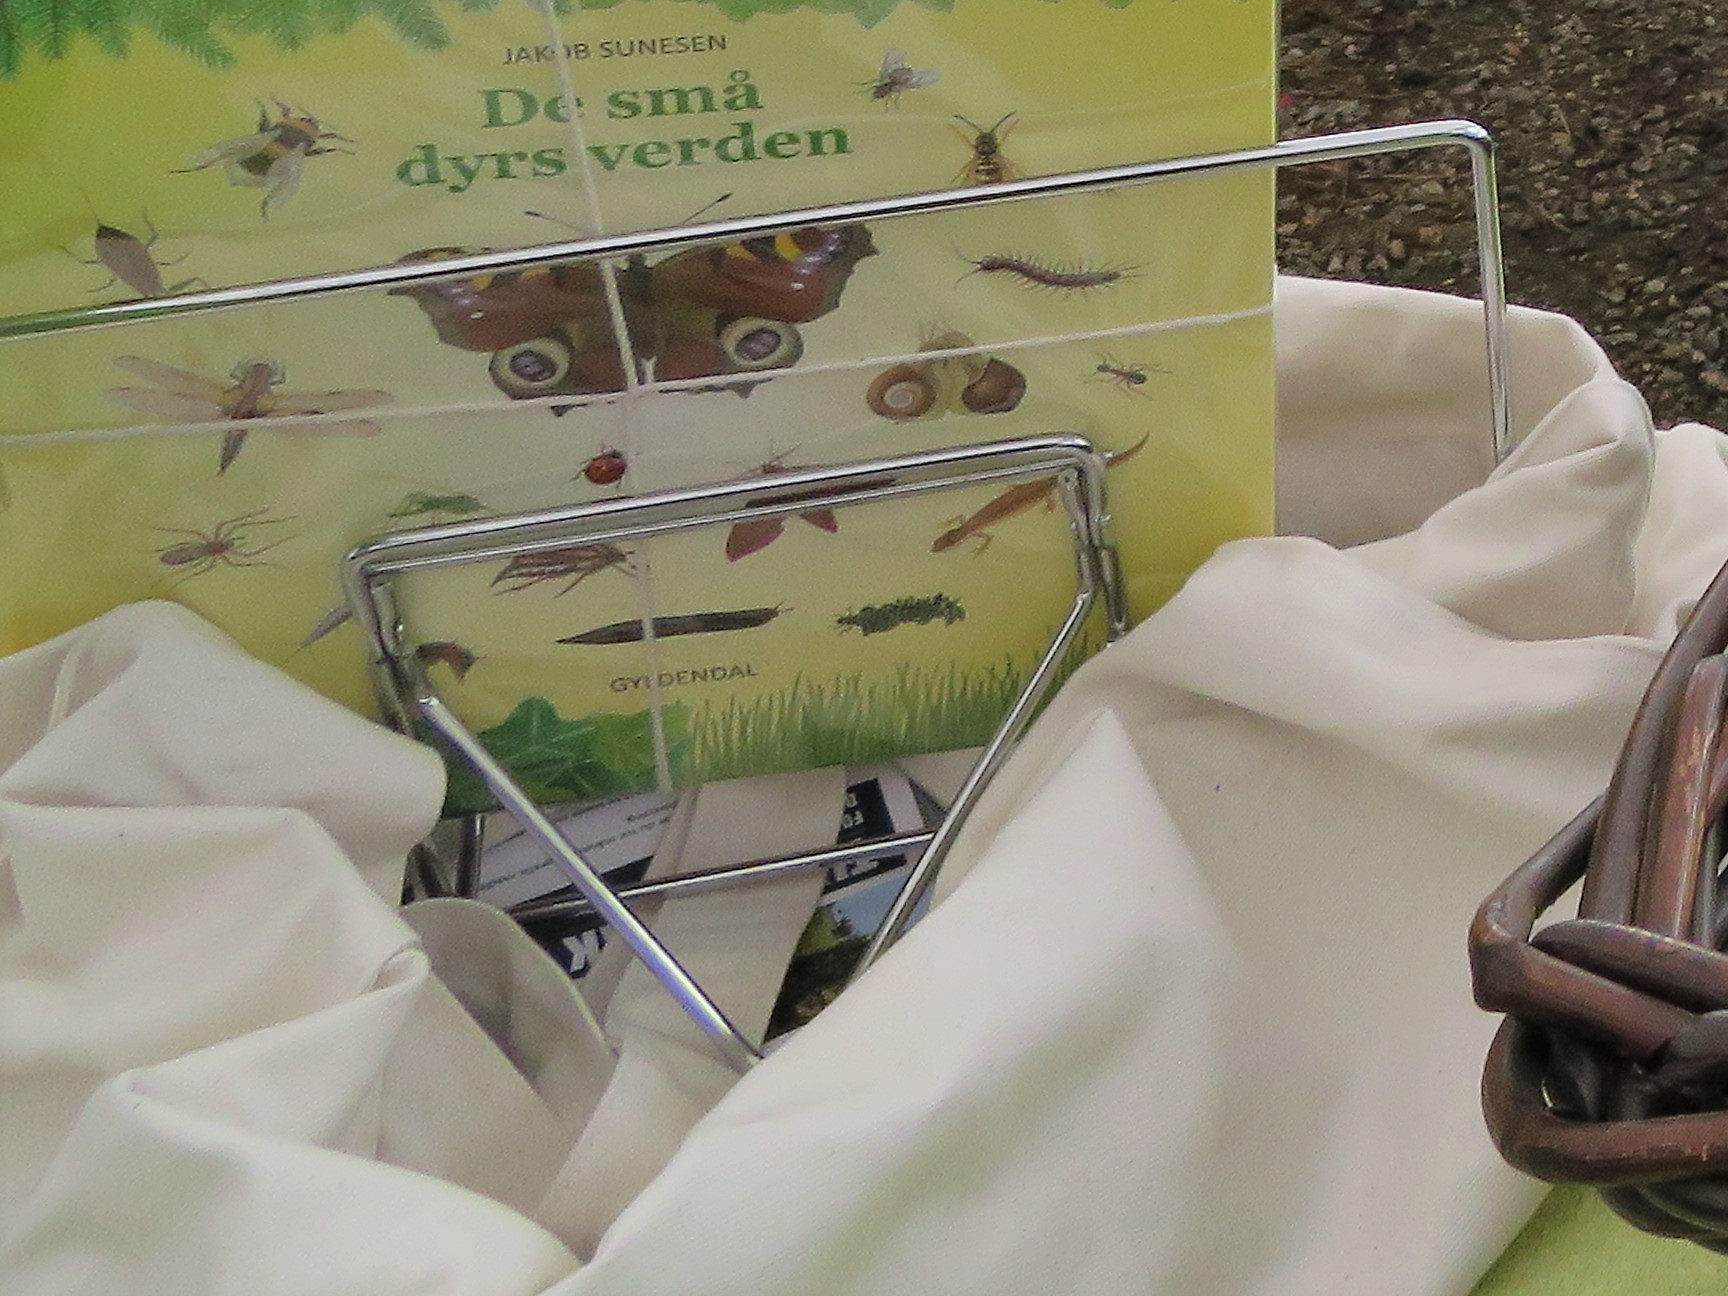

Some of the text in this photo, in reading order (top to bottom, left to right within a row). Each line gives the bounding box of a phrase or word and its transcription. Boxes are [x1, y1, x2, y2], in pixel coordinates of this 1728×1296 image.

[599, 33, 728, 60] SUNESEN
[477, 67, 766, 131] De små
[395, 120, 855, 195] dyrs verden
